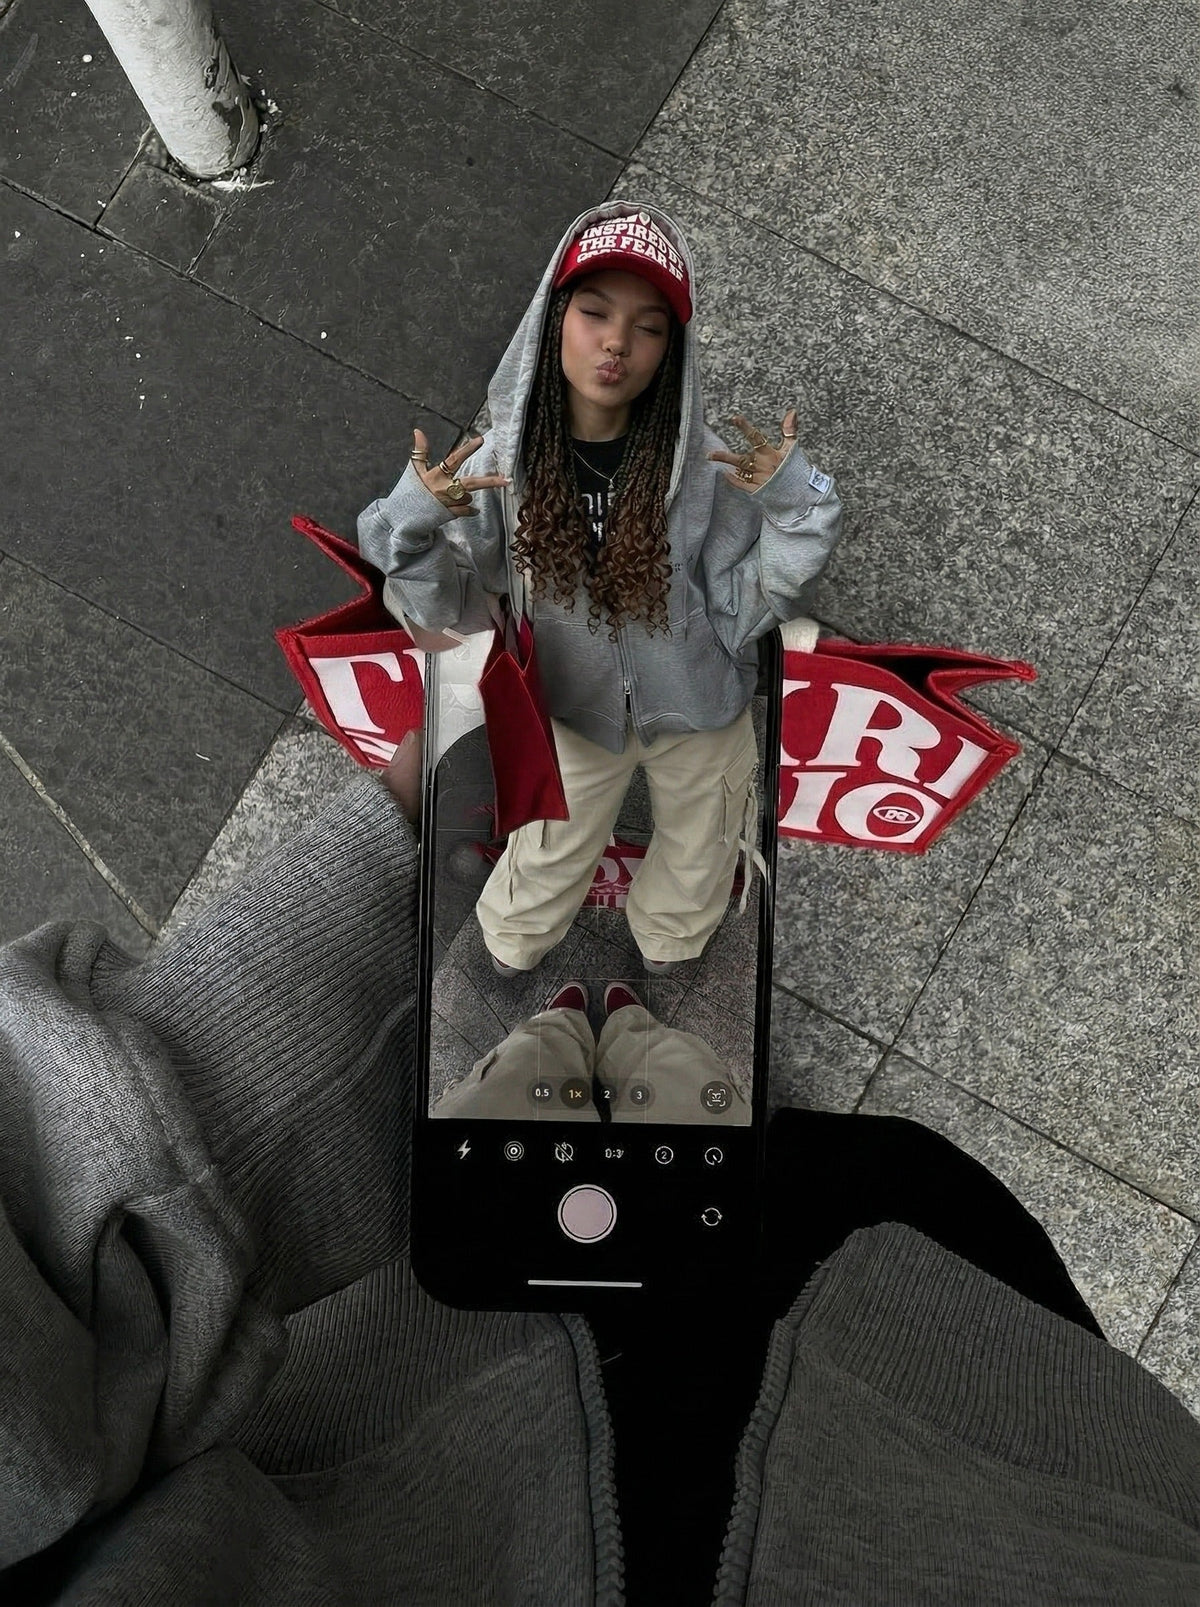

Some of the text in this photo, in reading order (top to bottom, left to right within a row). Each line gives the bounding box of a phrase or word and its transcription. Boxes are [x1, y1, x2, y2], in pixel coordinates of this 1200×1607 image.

[581, 223, 667, 254] INSPIRED
[579, 235, 617, 252] THE
[620, 236, 668, 269] FEAR
[535, 1088, 550, 1097] 0.5
[604, 1090, 611, 1099] 2
[636, 1091, 643, 1099] 3
[661, 1151, 668, 1160] 2
